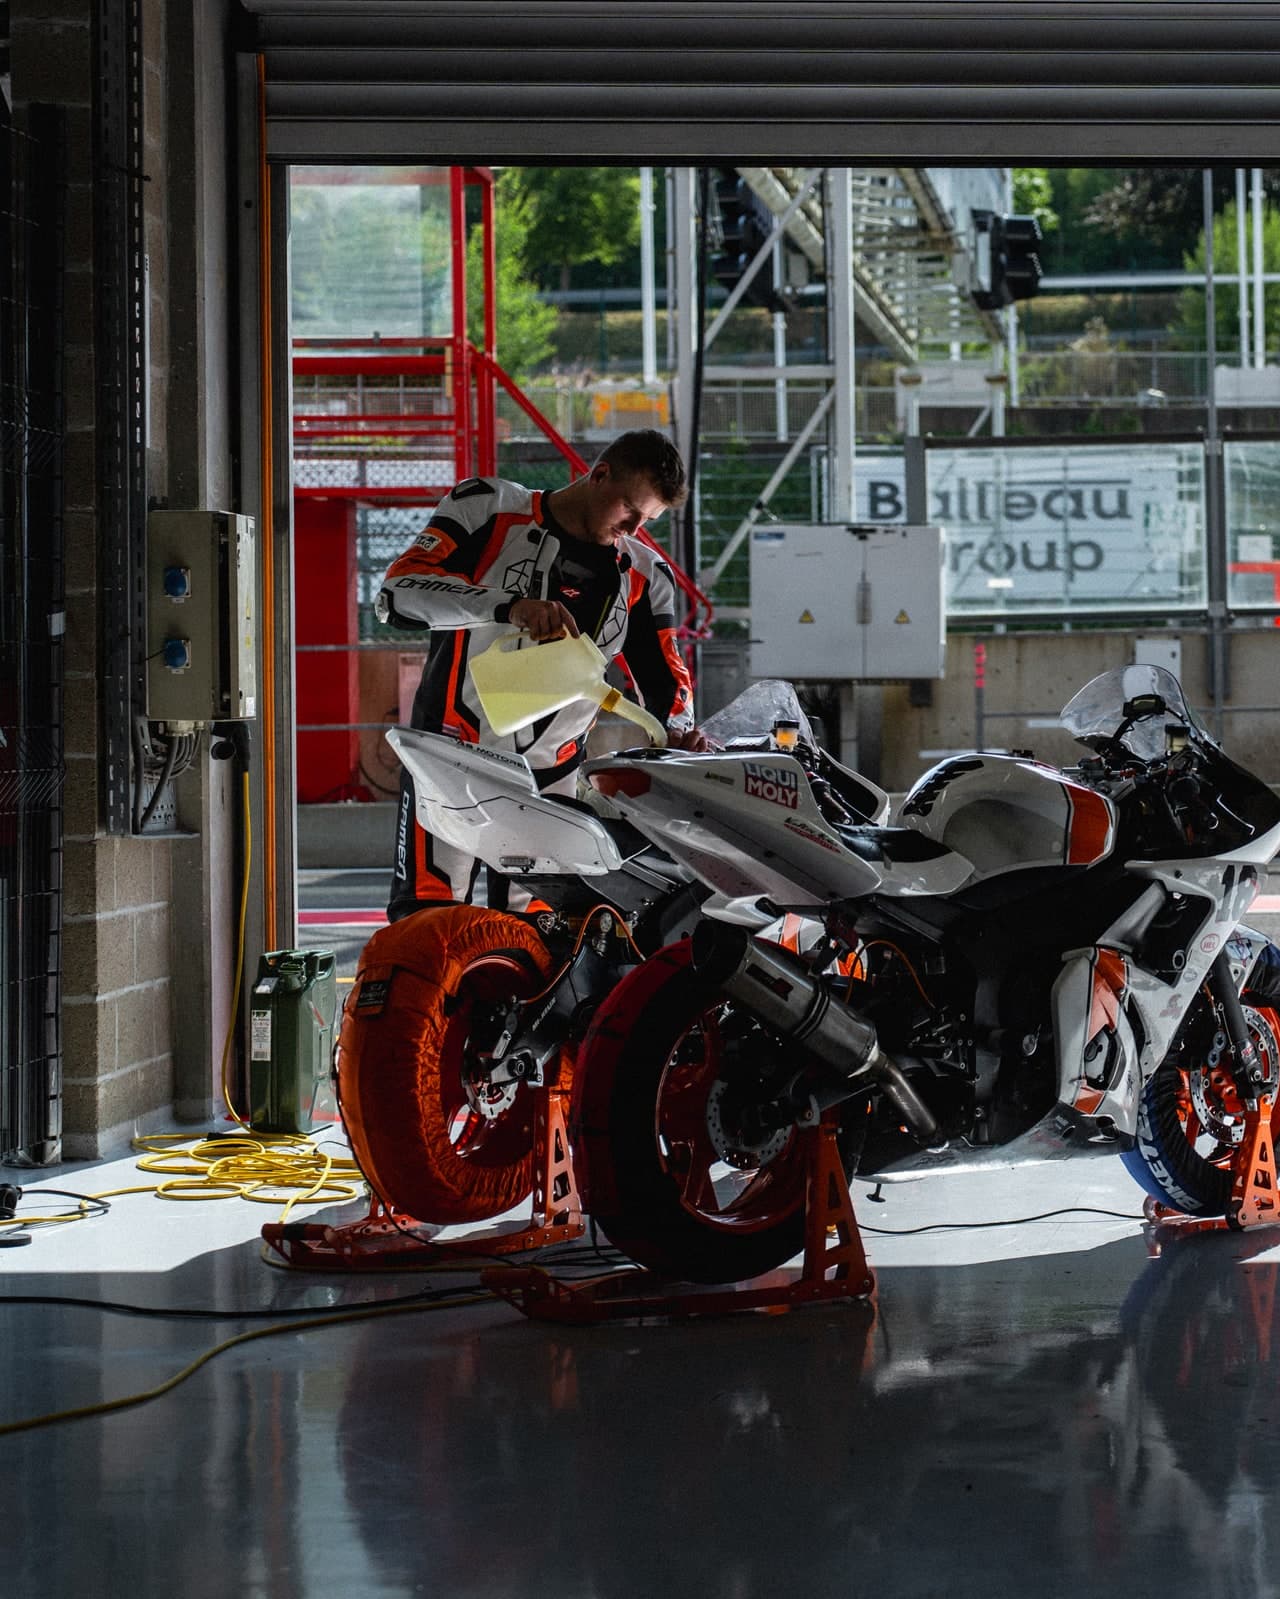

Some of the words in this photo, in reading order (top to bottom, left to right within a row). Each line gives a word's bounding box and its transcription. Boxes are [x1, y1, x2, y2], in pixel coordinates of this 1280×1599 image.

[945, 540, 1104, 582] roup
[744, 762, 796, 788] LIQUI
[746, 778, 796, 807] MOLY
[1137, 1092, 1202, 1211] BIKETE
